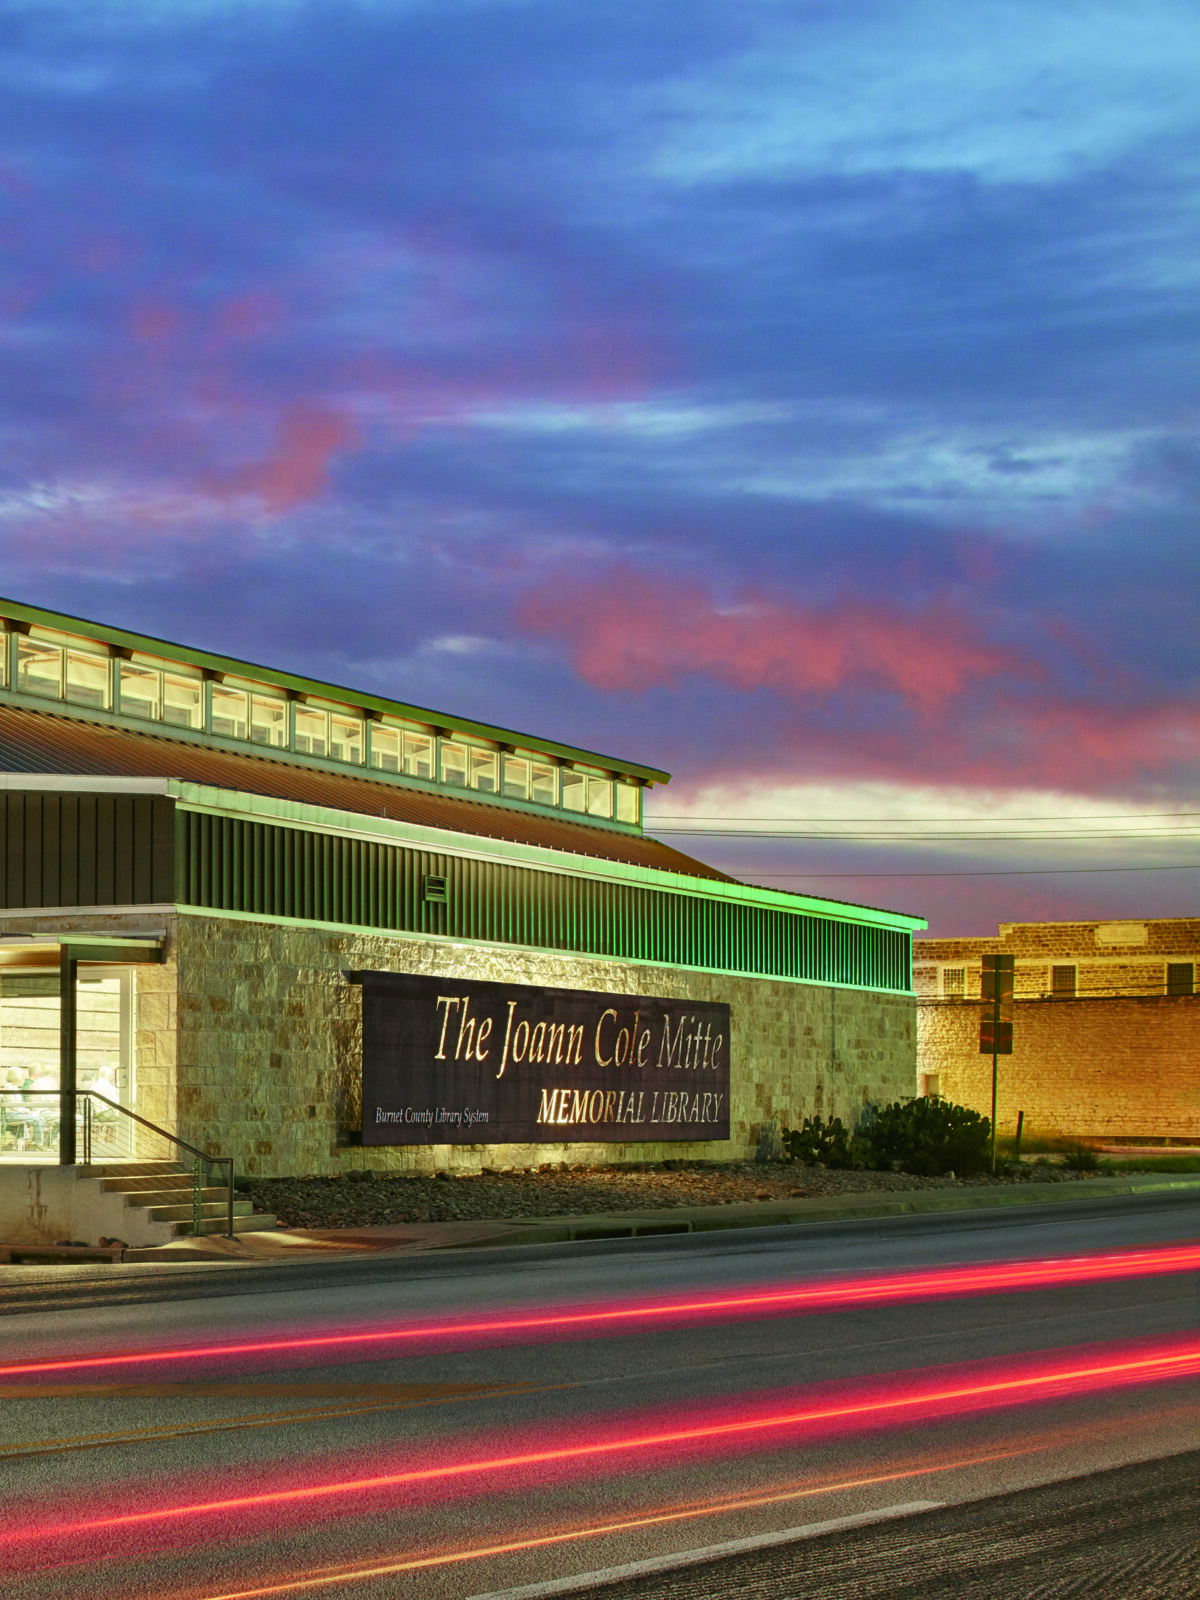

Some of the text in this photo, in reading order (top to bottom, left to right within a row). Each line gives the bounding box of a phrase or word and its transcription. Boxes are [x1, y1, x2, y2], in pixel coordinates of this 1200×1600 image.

[434, 995, 723, 1079] The Joann Cole Mitte
[376, 1107, 489, 1128] Burnet County Library System
[536, 1088, 724, 1124] MEMORIAL LIBRARY
